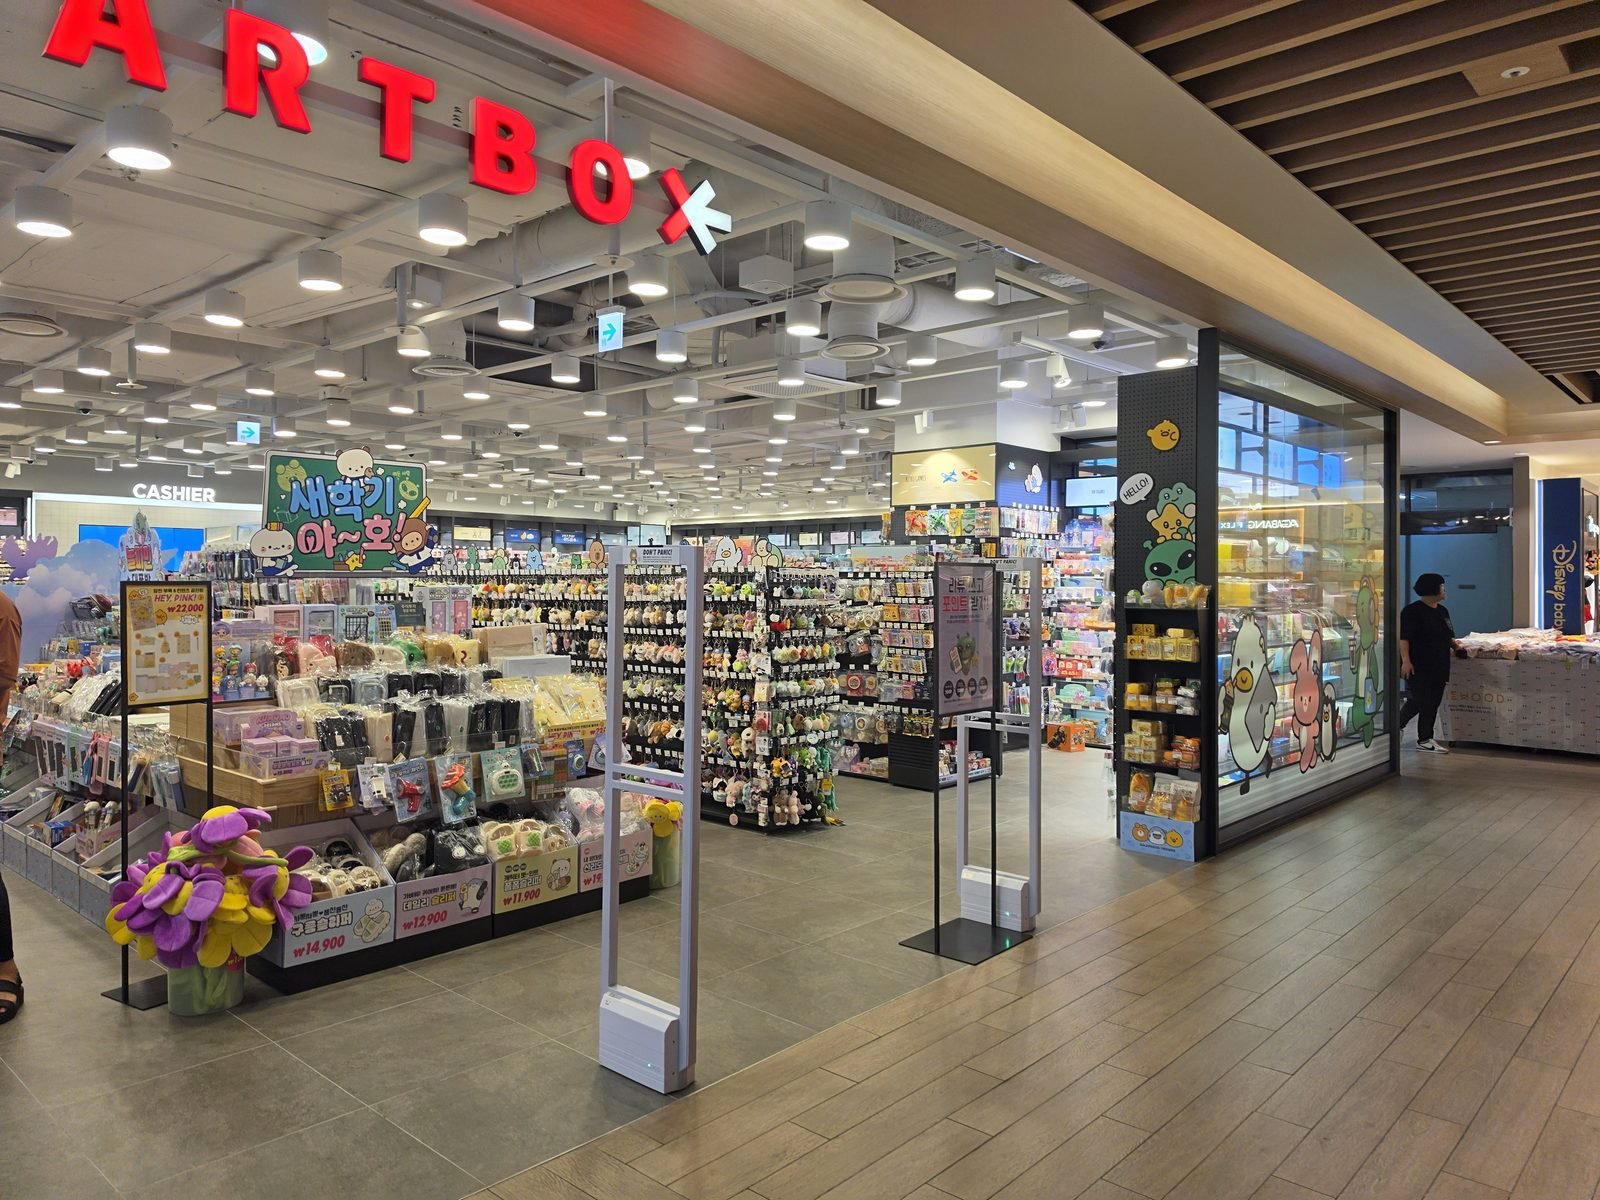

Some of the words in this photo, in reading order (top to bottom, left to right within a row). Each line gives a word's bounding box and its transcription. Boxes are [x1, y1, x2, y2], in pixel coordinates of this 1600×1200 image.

[42, 0, 732, 256] ARTBOX
[132, 483, 216, 503] CASHIER
[289, 475, 395, 523] 새학기
[1123, 478, 1149, 500] HELLO!
[296, 512, 408, 559] 야~호!
[948, 577, 966, 593] 리뷰
[174, 594, 197, 602] PINK!
[942, 595, 969, 612] 포인트
[583, 861, 604, 873] 산리오
[402, 896, 430, 911] 데일리
[431, 890, 457, 906] 슬리퍼
[291, 911, 353, 937] 구름슬리퍼
[402, 909, 448, 930] ₩12,900
[293, 934, 346, 958] ₩14,900
